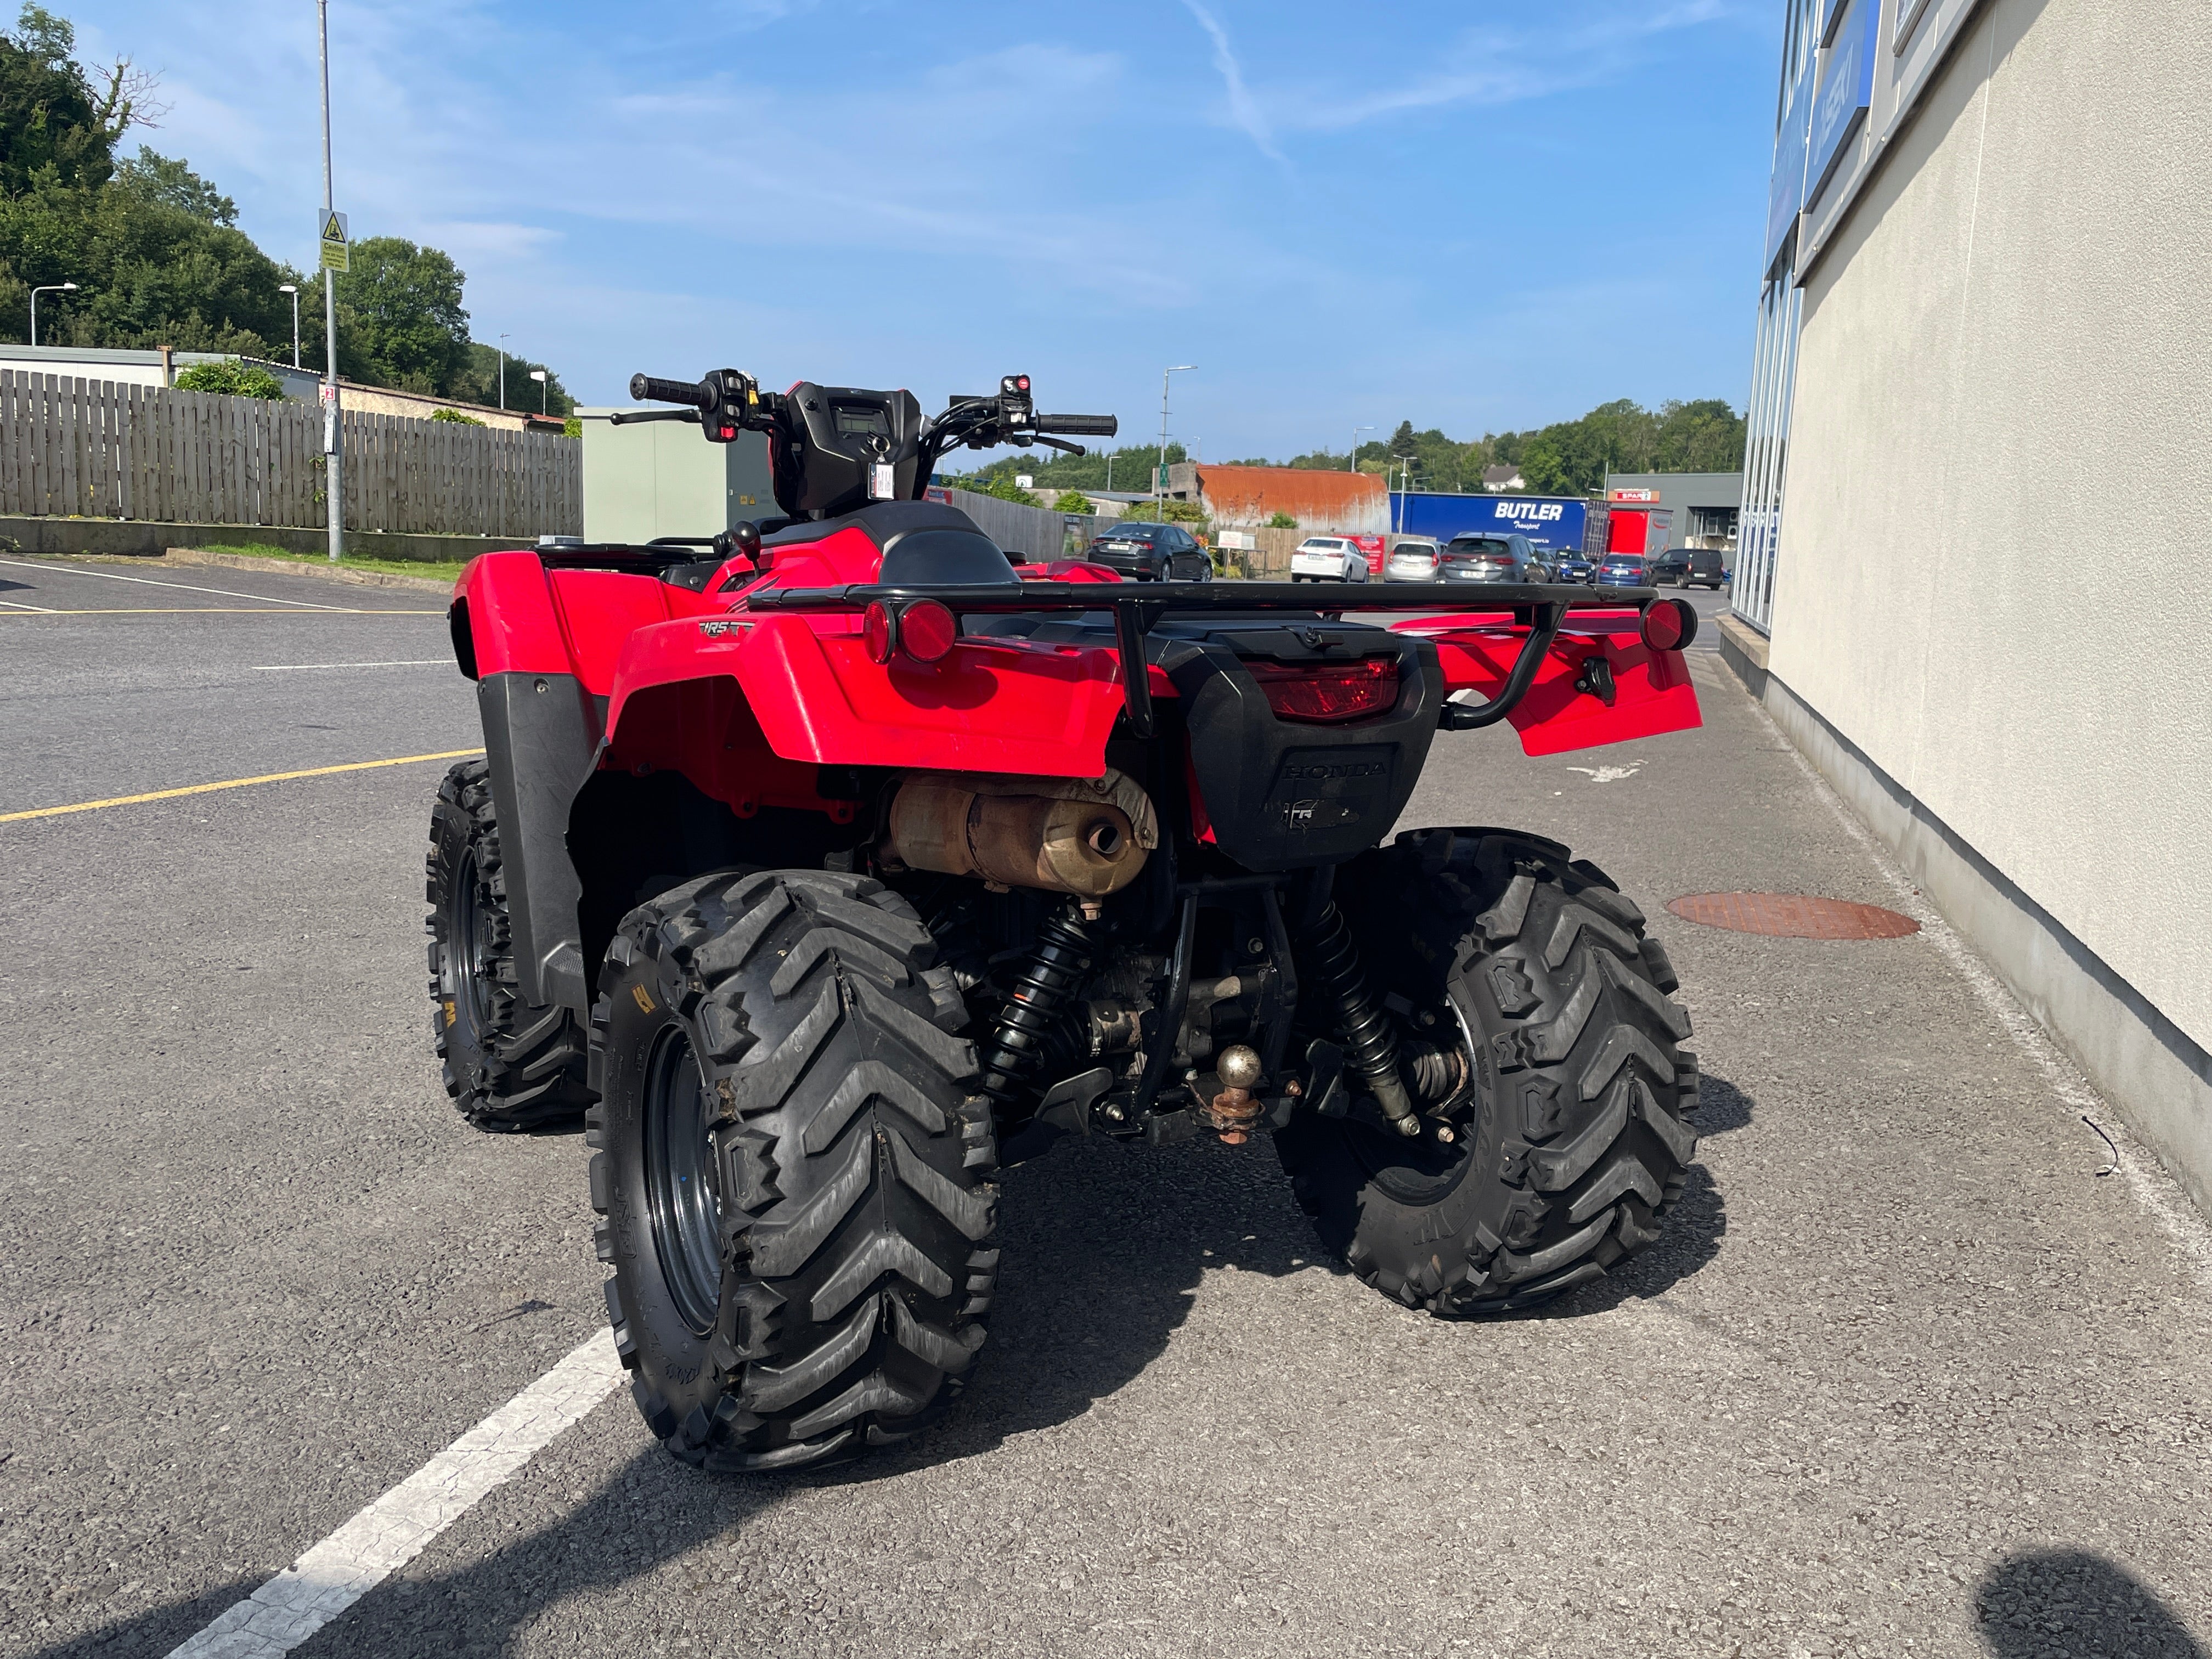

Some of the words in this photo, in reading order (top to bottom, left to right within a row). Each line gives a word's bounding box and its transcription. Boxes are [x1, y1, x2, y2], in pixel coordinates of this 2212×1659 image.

[324, 242, 345, 253] Caution
[326, 388, 332, 399] 2
[1494, 502, 1563, 521] BUTLER
[1513, 520, 1541, 531] Transport
[1281, 761, 1387, 780] HONDA
